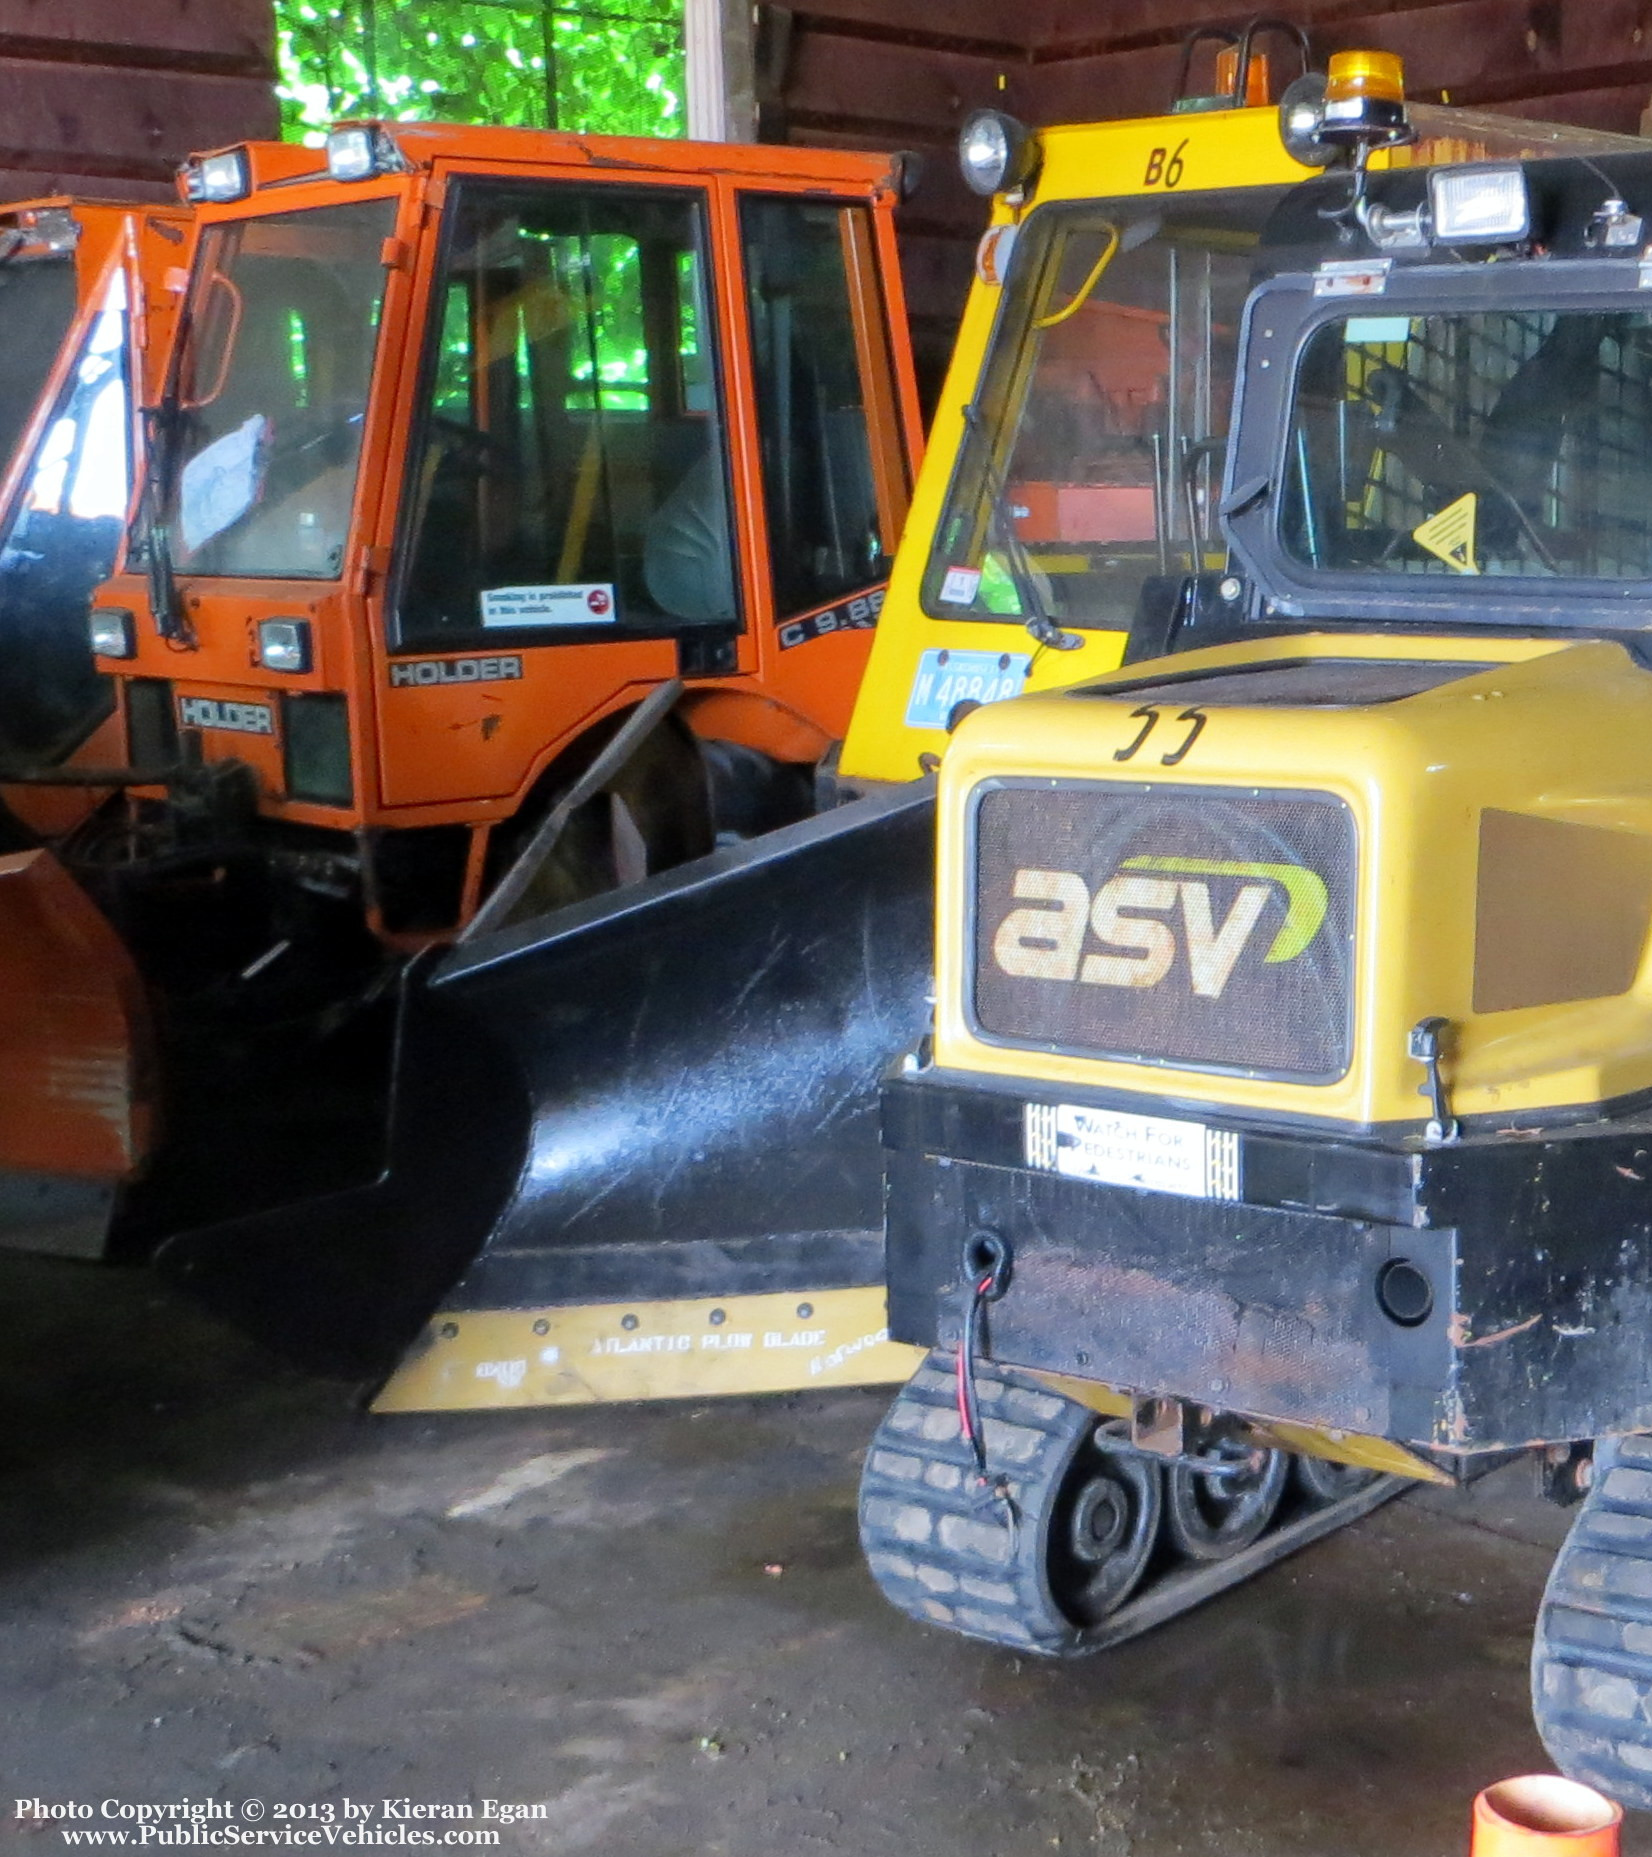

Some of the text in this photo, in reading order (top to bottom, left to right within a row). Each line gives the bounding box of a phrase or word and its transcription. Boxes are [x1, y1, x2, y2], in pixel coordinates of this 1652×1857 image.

[1144, 138, 1190, 188] B6
[391, 656, 521, 688] HOLDER
[181, 698, 273, 735] HOLDER
[591, 1329, 827, 1355] ATLANTIC PLOW BLADE
